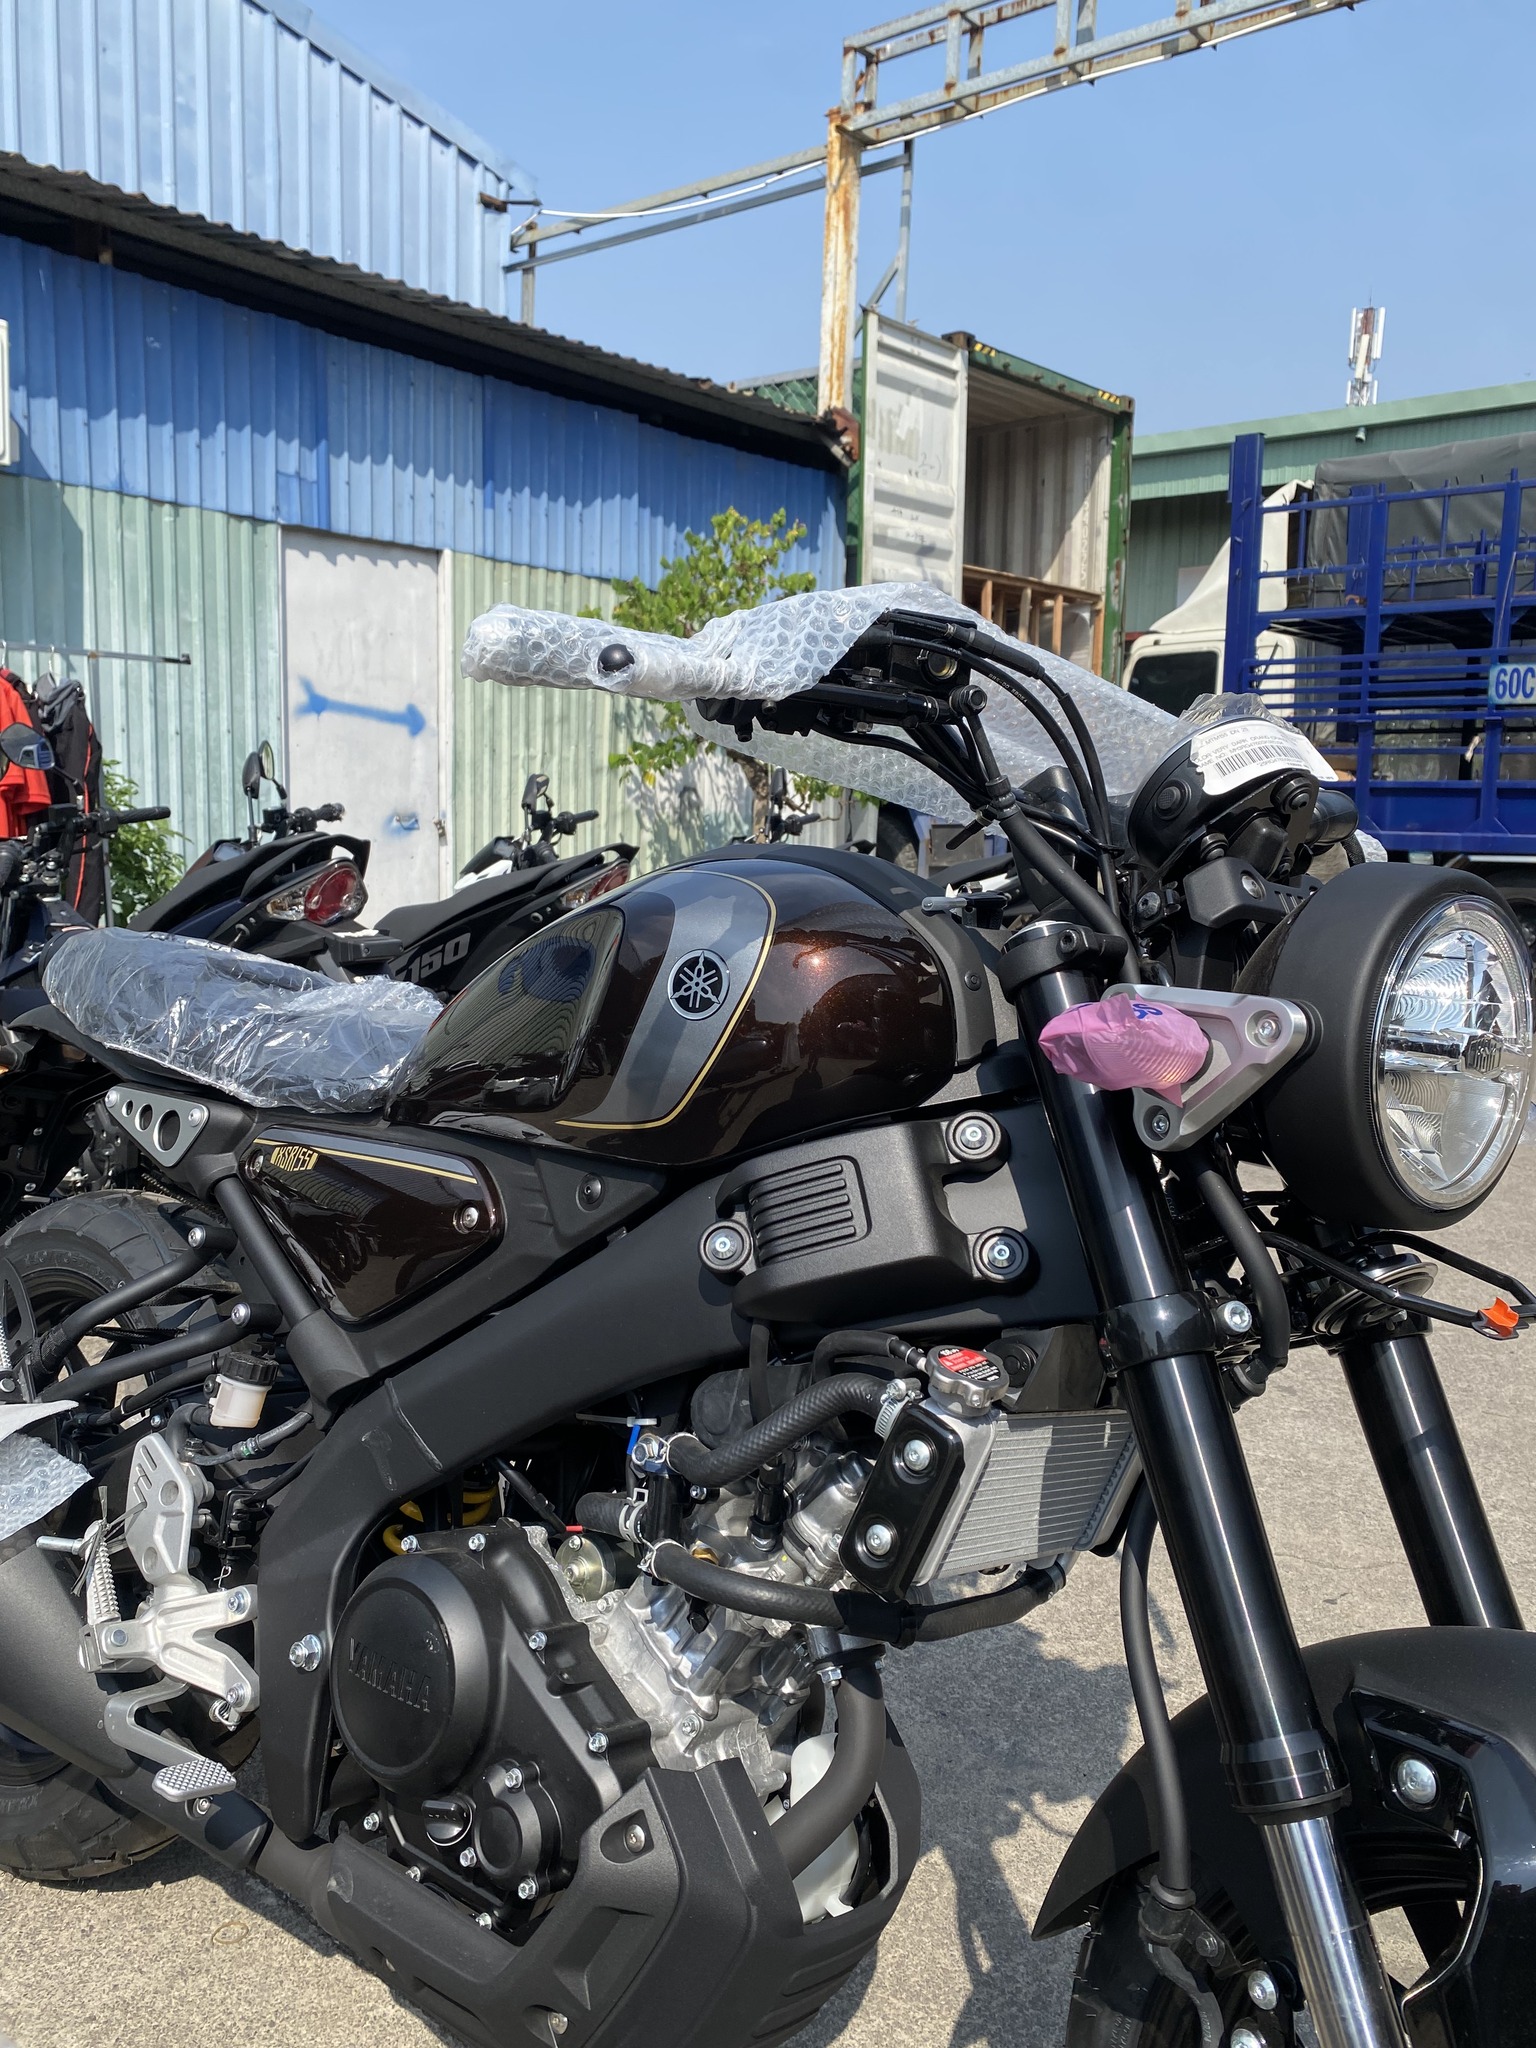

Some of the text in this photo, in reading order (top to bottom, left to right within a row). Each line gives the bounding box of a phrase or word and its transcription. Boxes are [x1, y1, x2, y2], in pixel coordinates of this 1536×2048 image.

[1495, 667, 1535, 699] 60C
[275, 1146, 313, 1171] XSR155
[349, 1637, 431, 1712] YAMAHA
